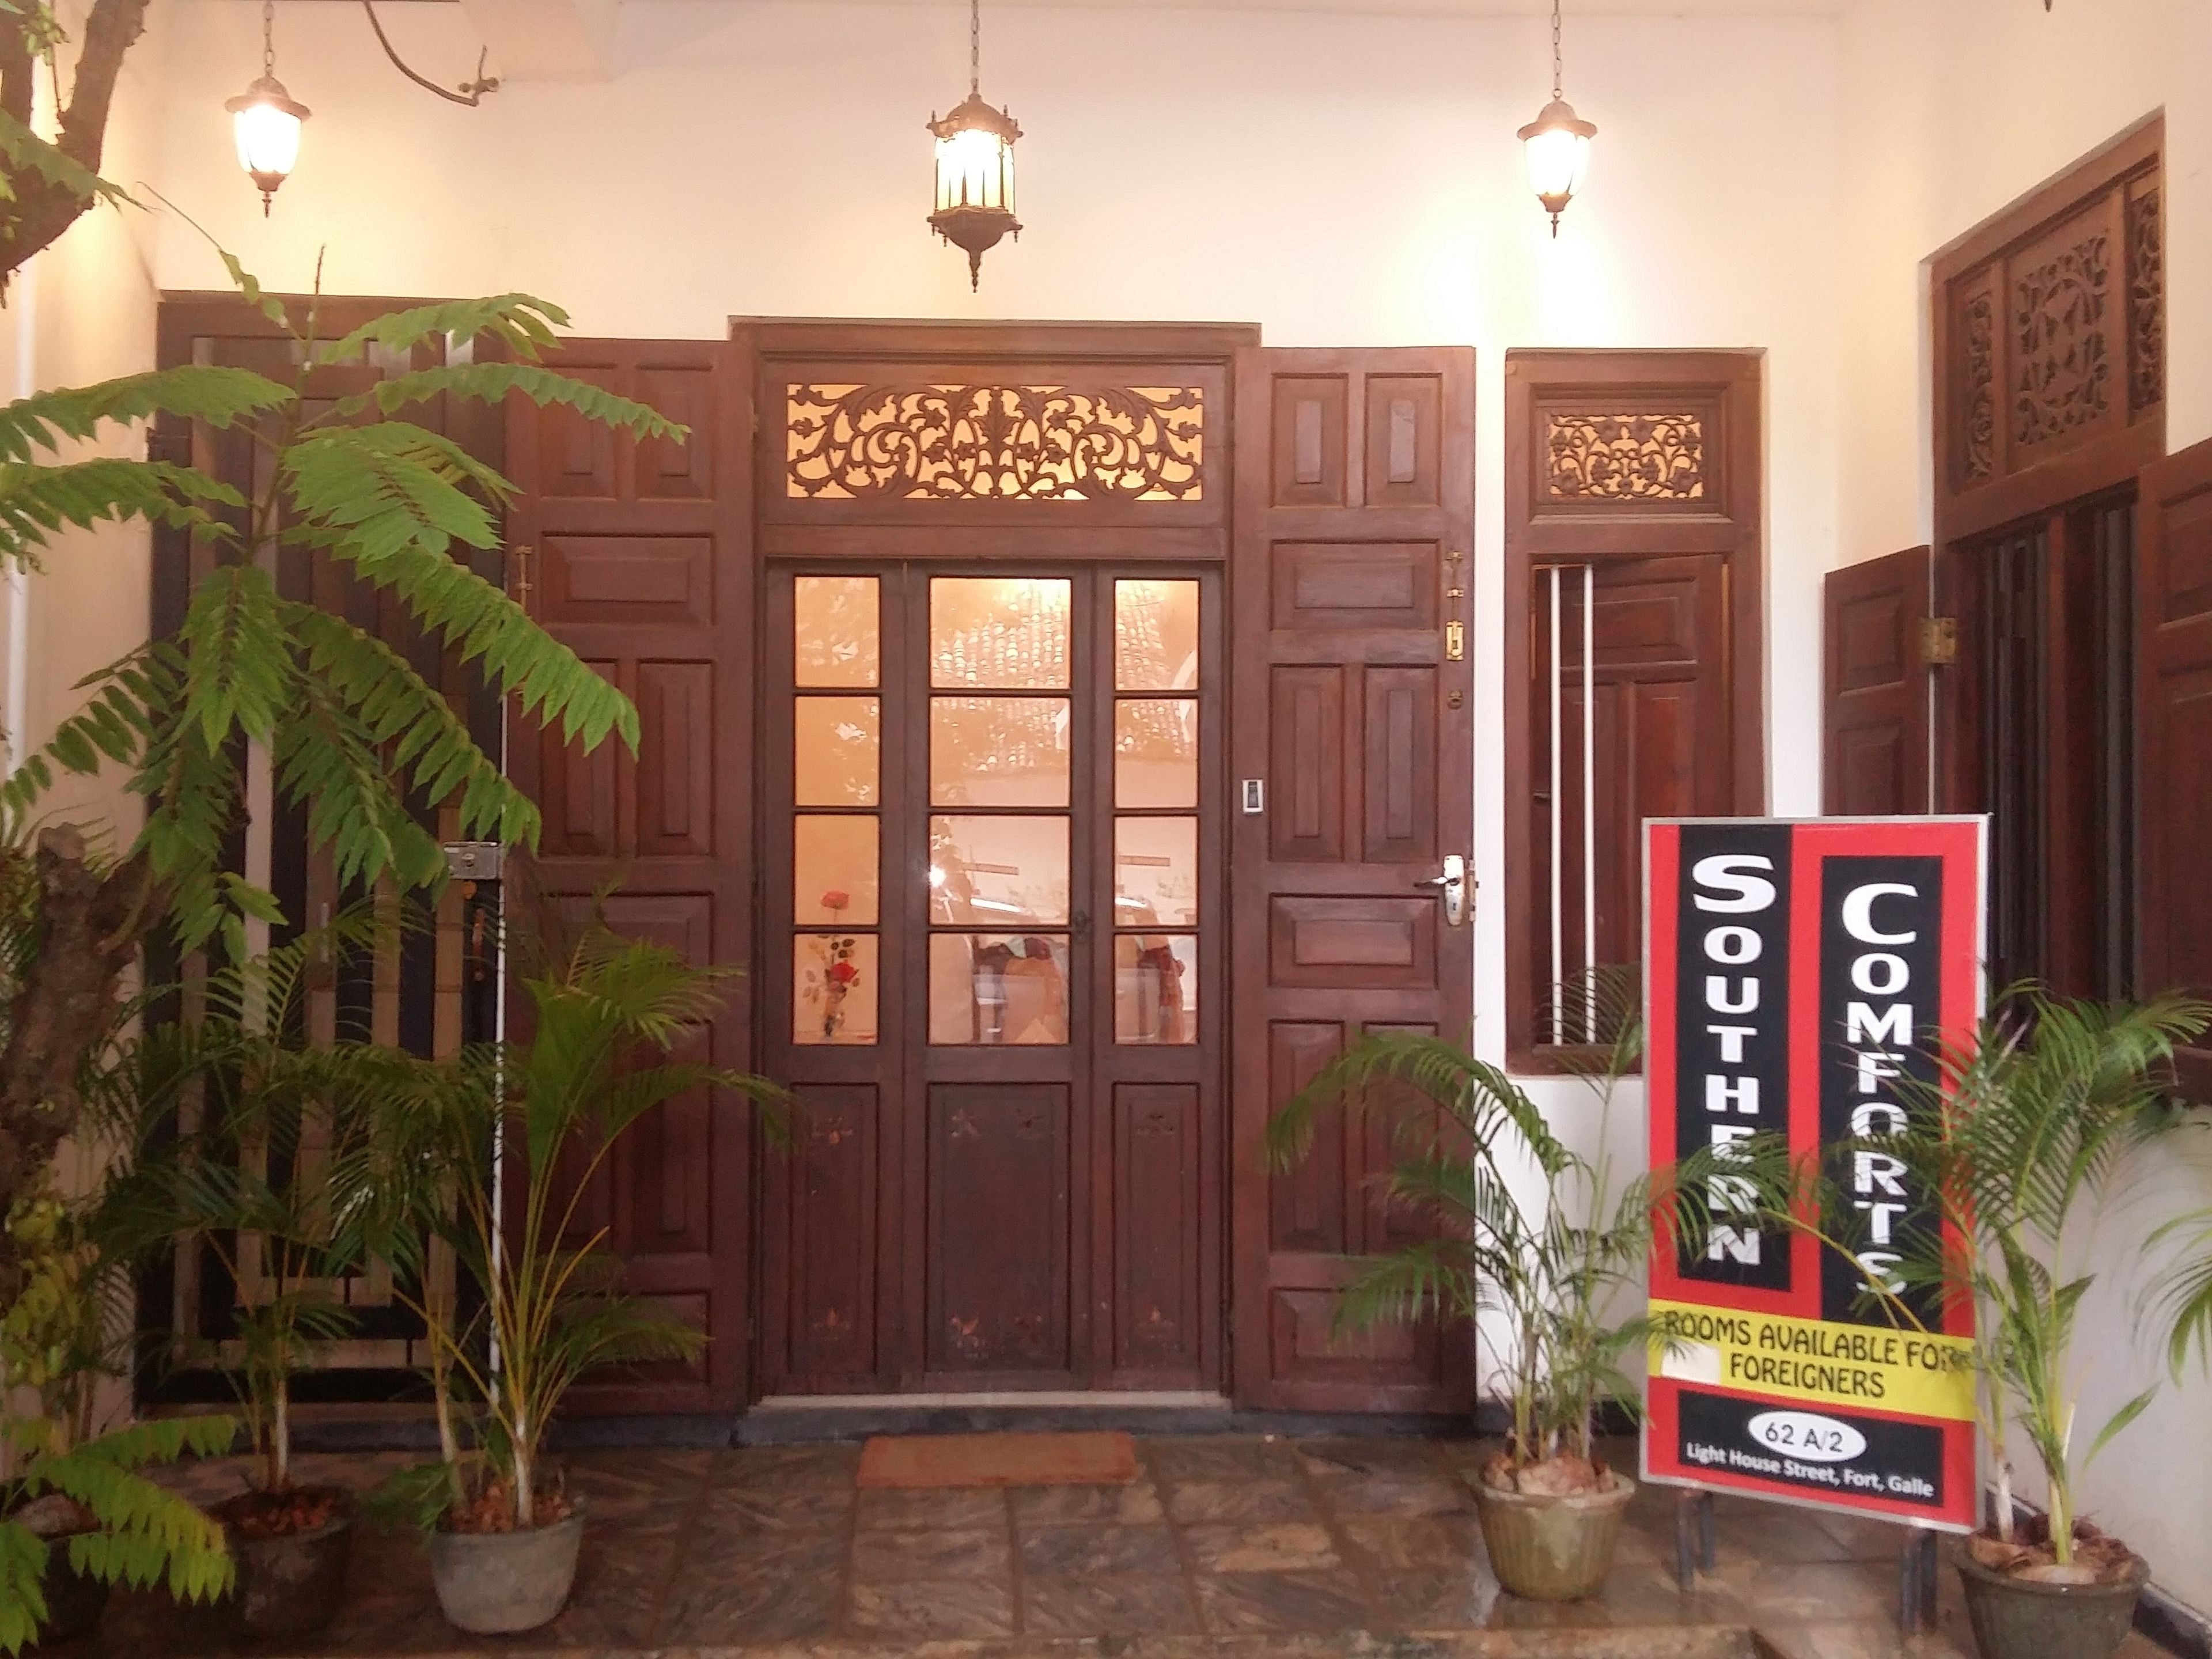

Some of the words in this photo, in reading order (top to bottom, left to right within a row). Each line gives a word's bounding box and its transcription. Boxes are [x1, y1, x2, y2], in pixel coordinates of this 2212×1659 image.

[1692, 854, 1777, 1265] SOUTHERN
[1842, 882, 1919, 1295] COMFORTS
[1665, 1310, 1751, 1345] ROOMS
[1760, 1323, 1898, 1365] AVAILABLE
[1731, 1352, 1885, 1398] FOREIGNERS
[1765, 1421, 1794, 1445] 62
[1803, 1428, 1843, 1452] A/2
[1686, 1442, 1726, 1465] Light
[1729, 1450, 1781, 1475] House
[1783, 1460, 1840, 1487] Street,
[1844, 1468, 1884, 1492] Fort,
[1888, 1475, 1934, 1498] Galle
